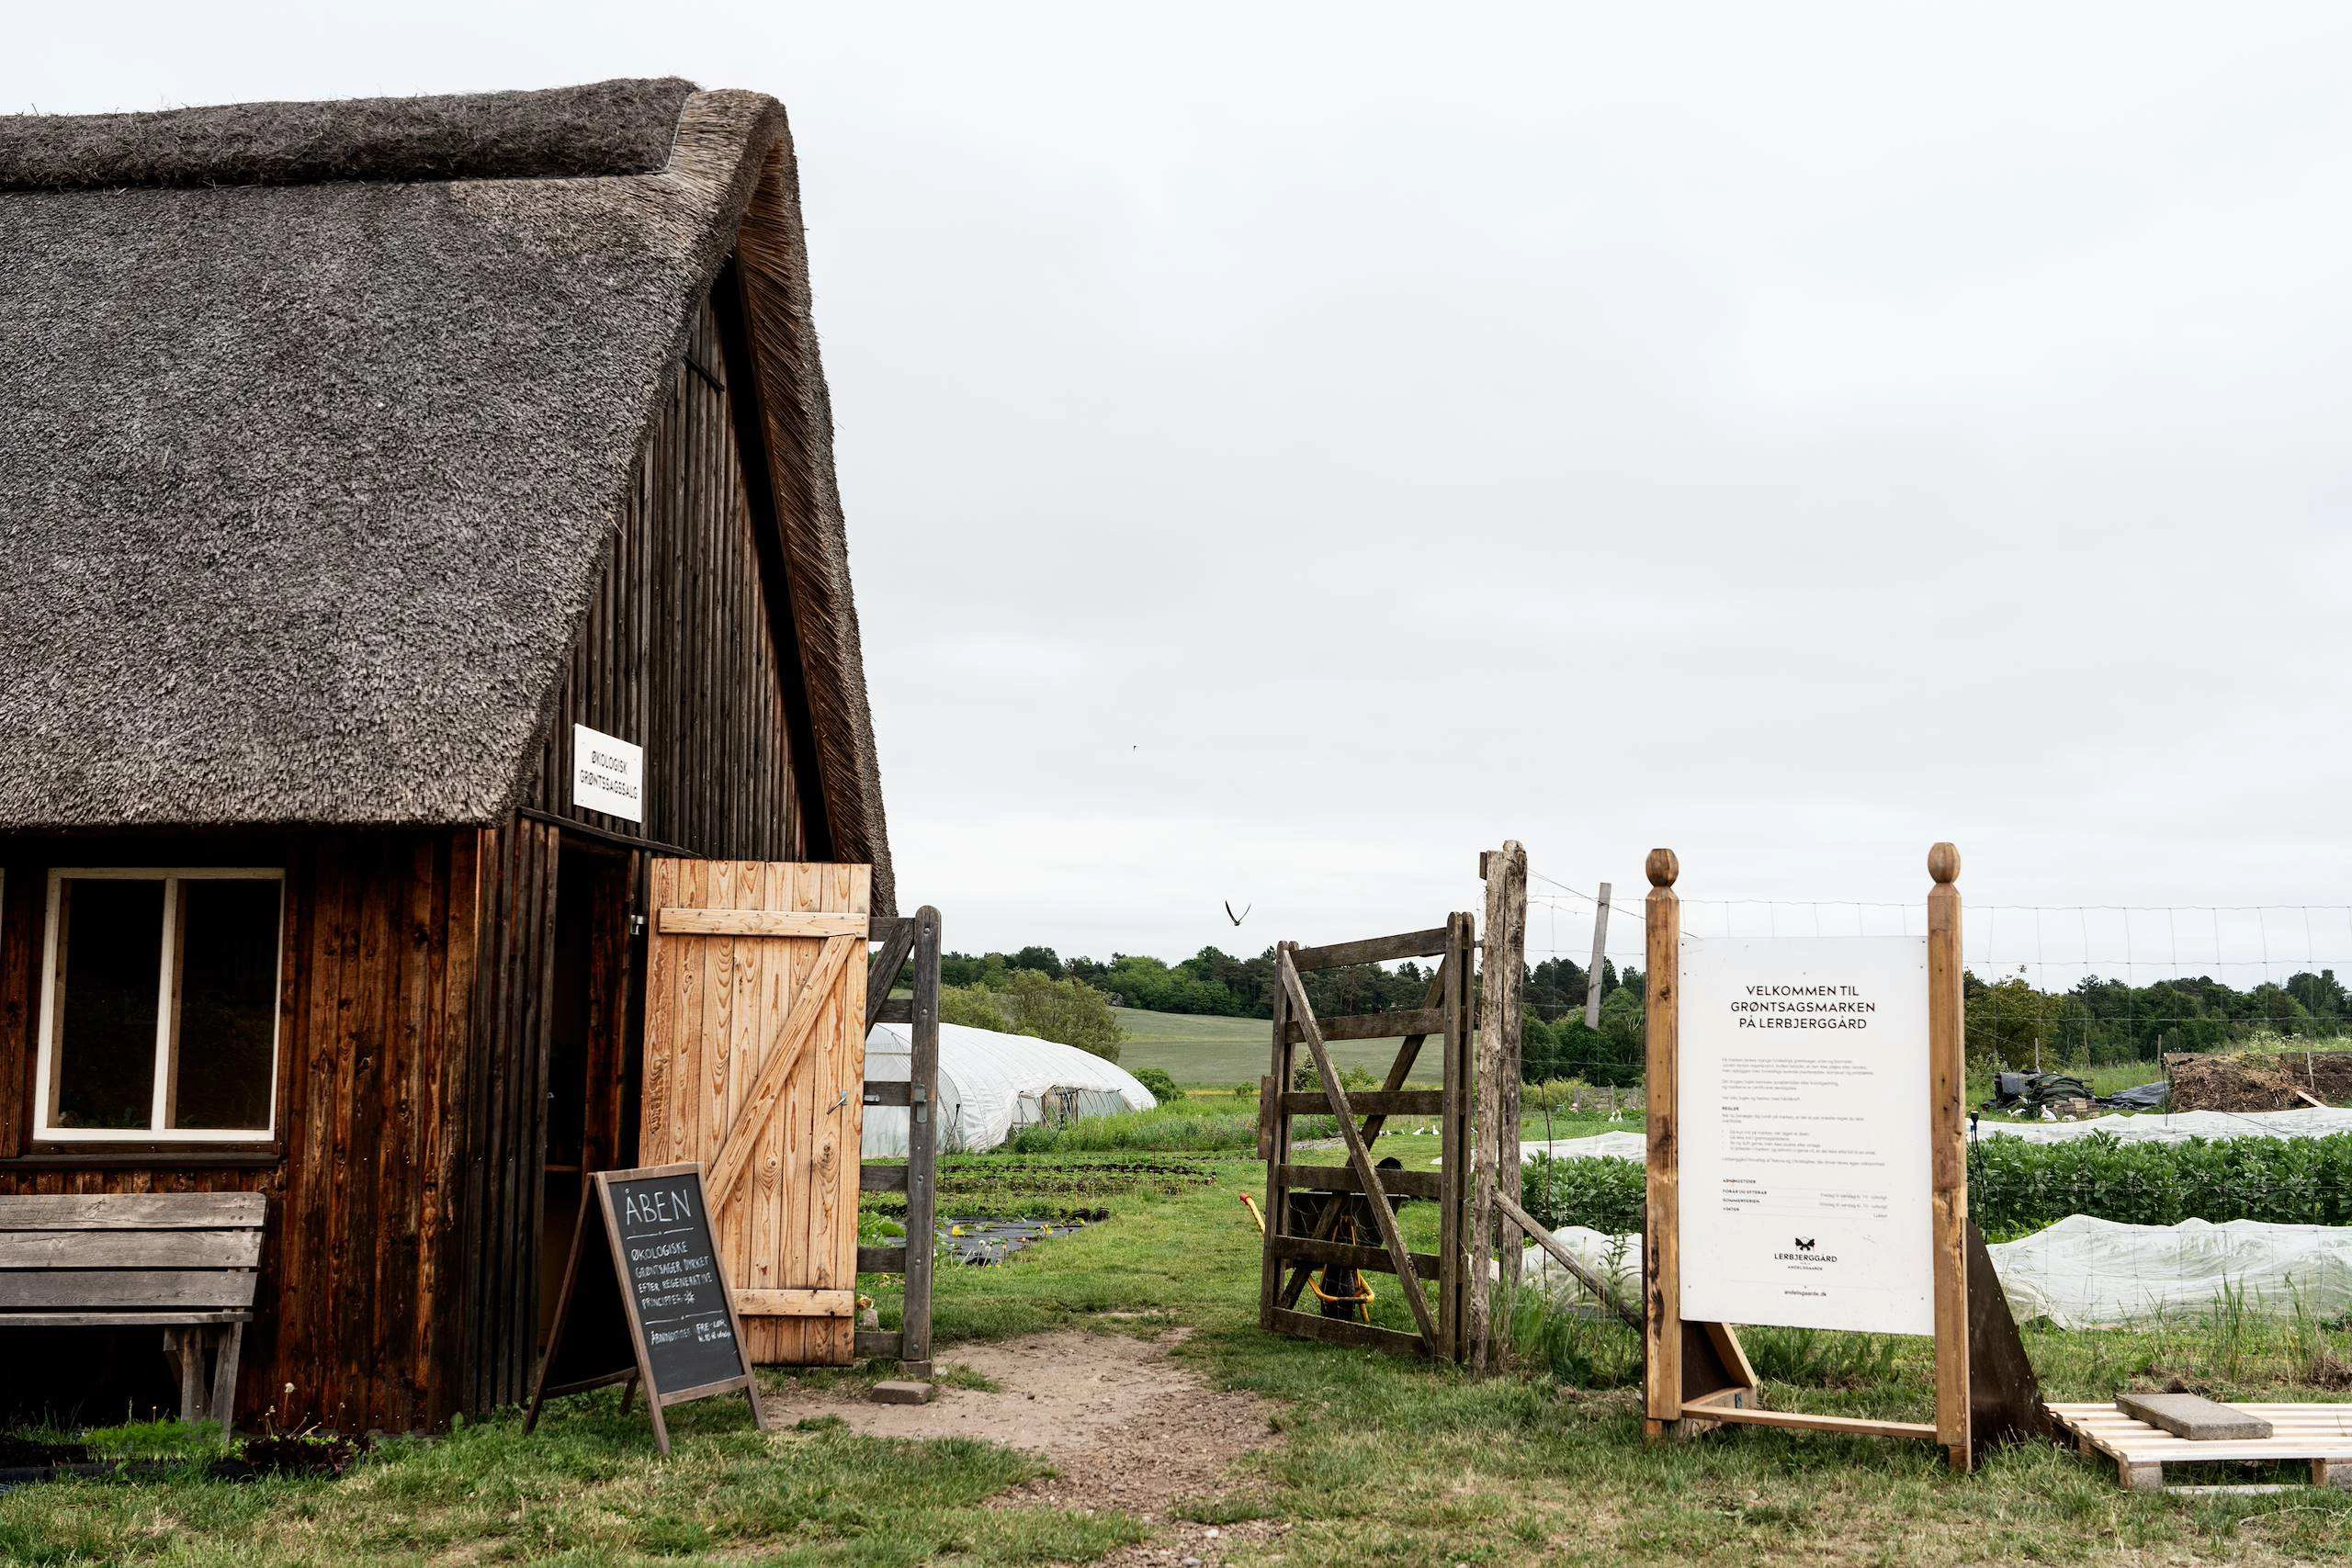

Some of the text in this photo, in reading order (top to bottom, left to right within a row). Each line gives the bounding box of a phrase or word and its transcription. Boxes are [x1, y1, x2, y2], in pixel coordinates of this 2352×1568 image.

[592, 750, 628, 774] ØKOLOGISK
[1746, 986, 1860, 997] VELKOMMEN TIL
[1730, 1001, 1876, 1012] GRØNTSAGSMARKEN
[1739, 1015, 1867, 1030] PÅ LERBJERGGÅRD
[626, 1188, 692, 1225] ÅBEN
[631, 1241, 688, 1261] ØKOLOGISKE
[1774, 1253, 1838, 1263] LERBJERGGÅRD
